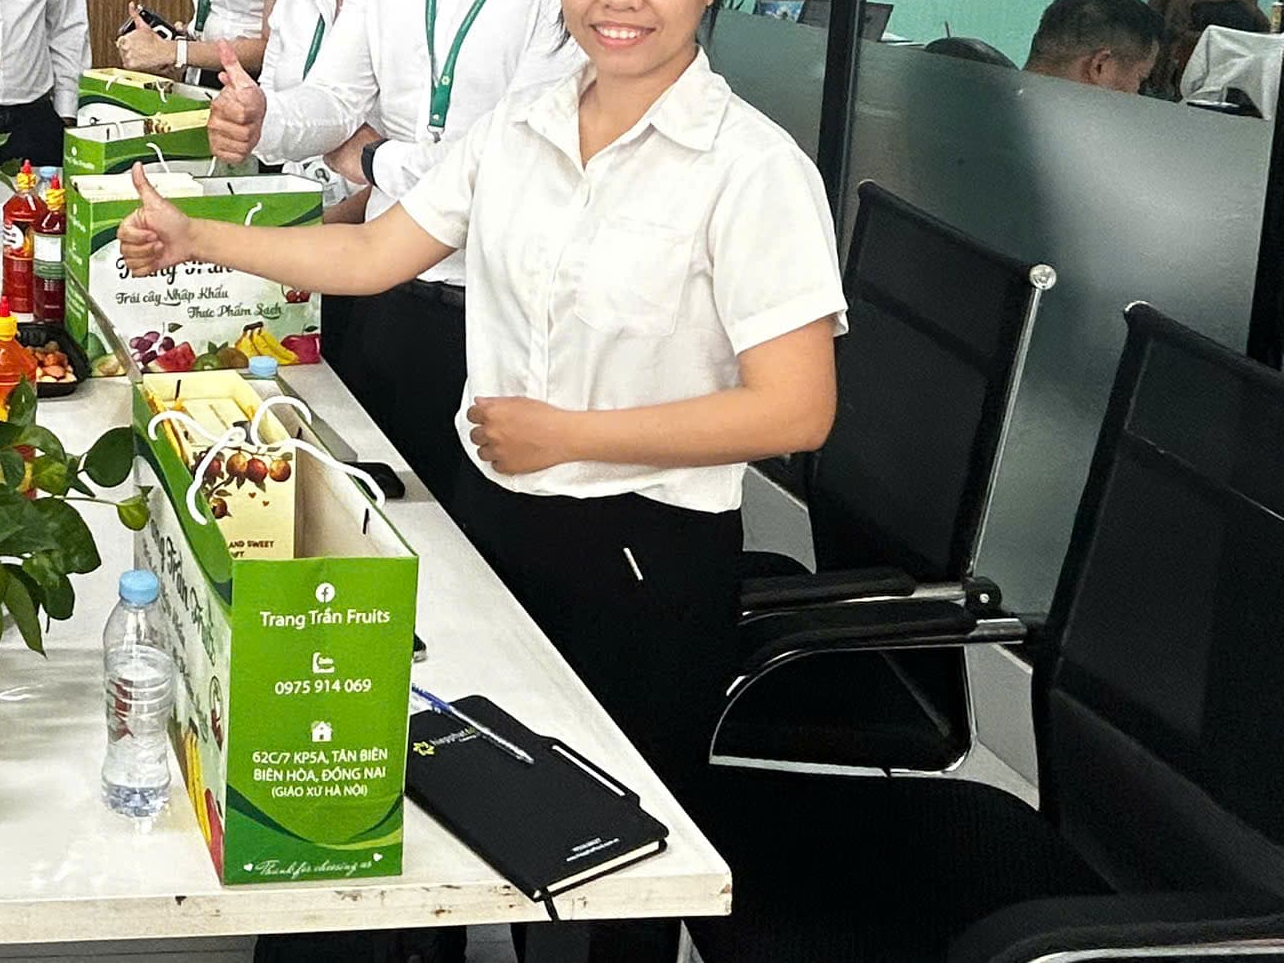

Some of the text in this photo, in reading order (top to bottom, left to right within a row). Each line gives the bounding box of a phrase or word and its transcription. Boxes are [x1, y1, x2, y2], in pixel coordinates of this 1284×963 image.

[142, 290, 162, 307] cây
[196, 283, 229, 300] Khẩu
[247, 540, 275, 548] SWEET
[259, 607, 391, 630] Trang Trần Fruits
[274, 678, 372, 695] 0975 914 069
[252, 747, 388, 765] 62C/7 KP5A, TÂN BIÊN
[253, 768, 284, 781] BIÊN
[286, 767, 319, 783] HÒA,
[363, 766, 386, 779] NAI
[271, 785, 304, 798] (GIÁO
[324, 783, 342, 797] HÀ
[343, 784, 369, 797] NỘI)
[255, 859, 372, 879] Thank for choosing us
